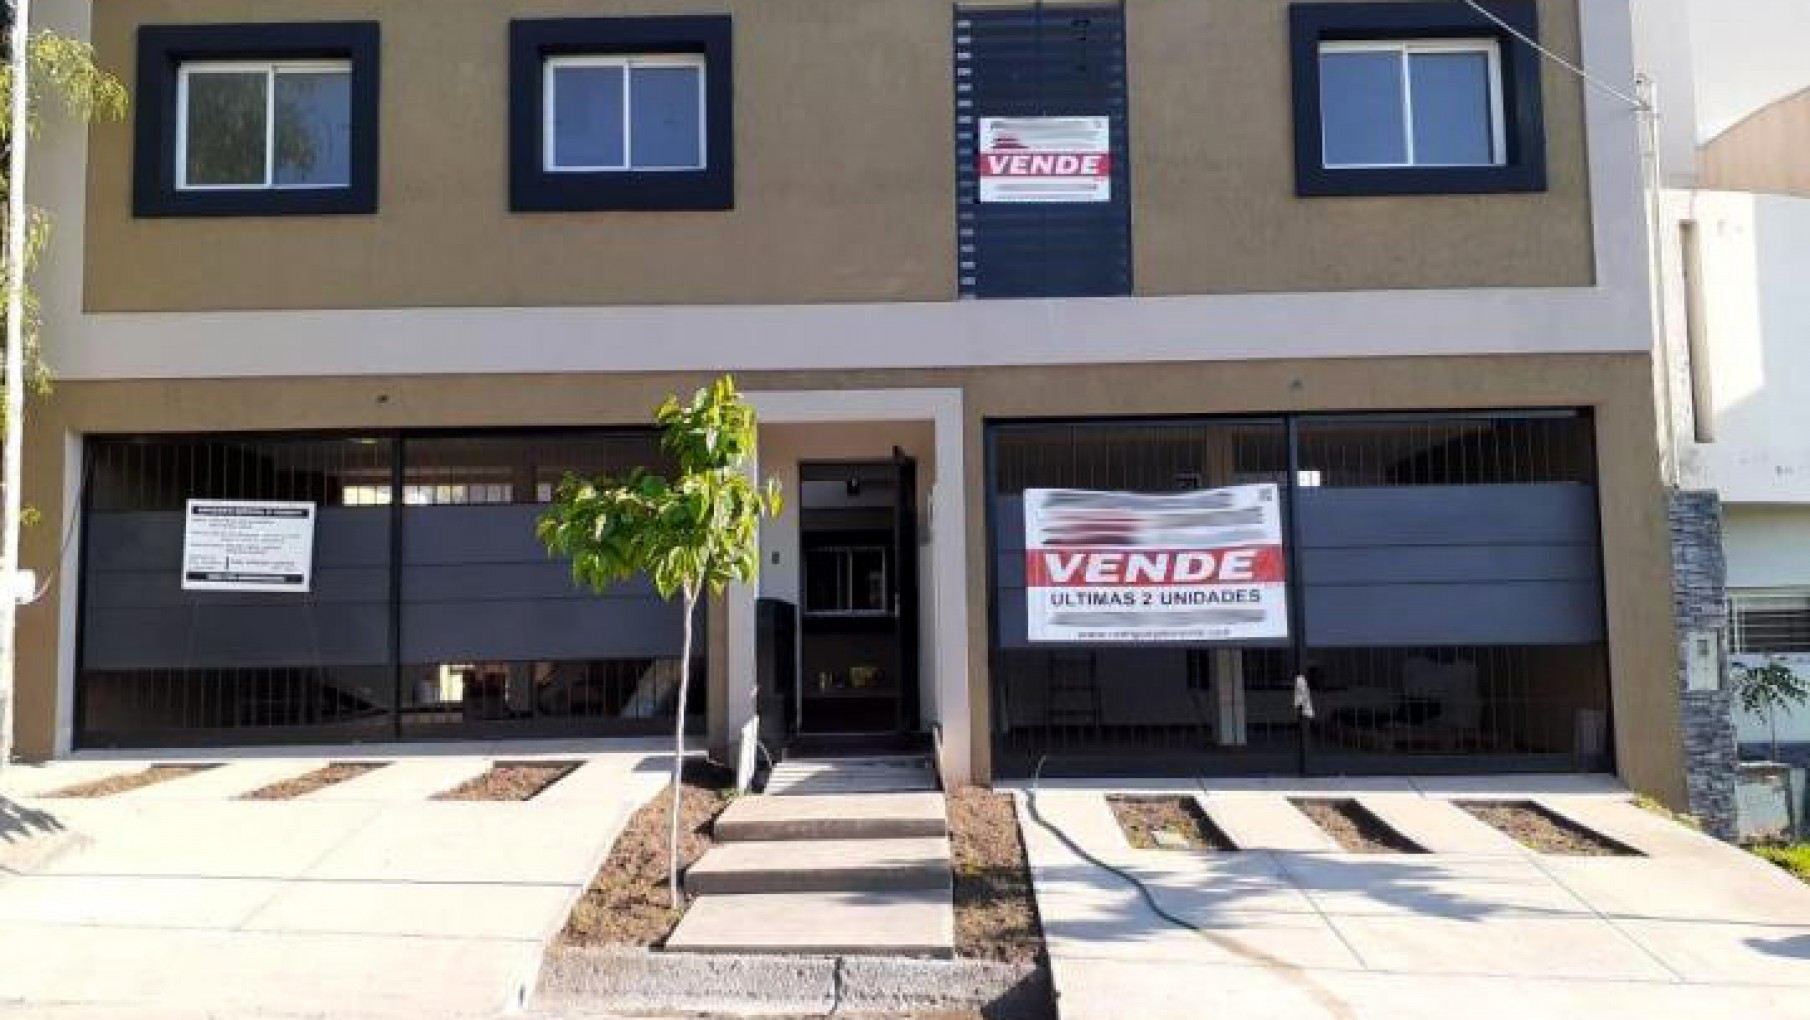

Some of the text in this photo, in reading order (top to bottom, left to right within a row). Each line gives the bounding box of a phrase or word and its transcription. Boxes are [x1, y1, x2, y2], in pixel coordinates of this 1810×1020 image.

[988, 155, 1101, 175] VENDE
[1045, 551, 1257, 583] VENDE
[1051, 589, 1261, 606] ULTIMAS 2 UNIDADES
